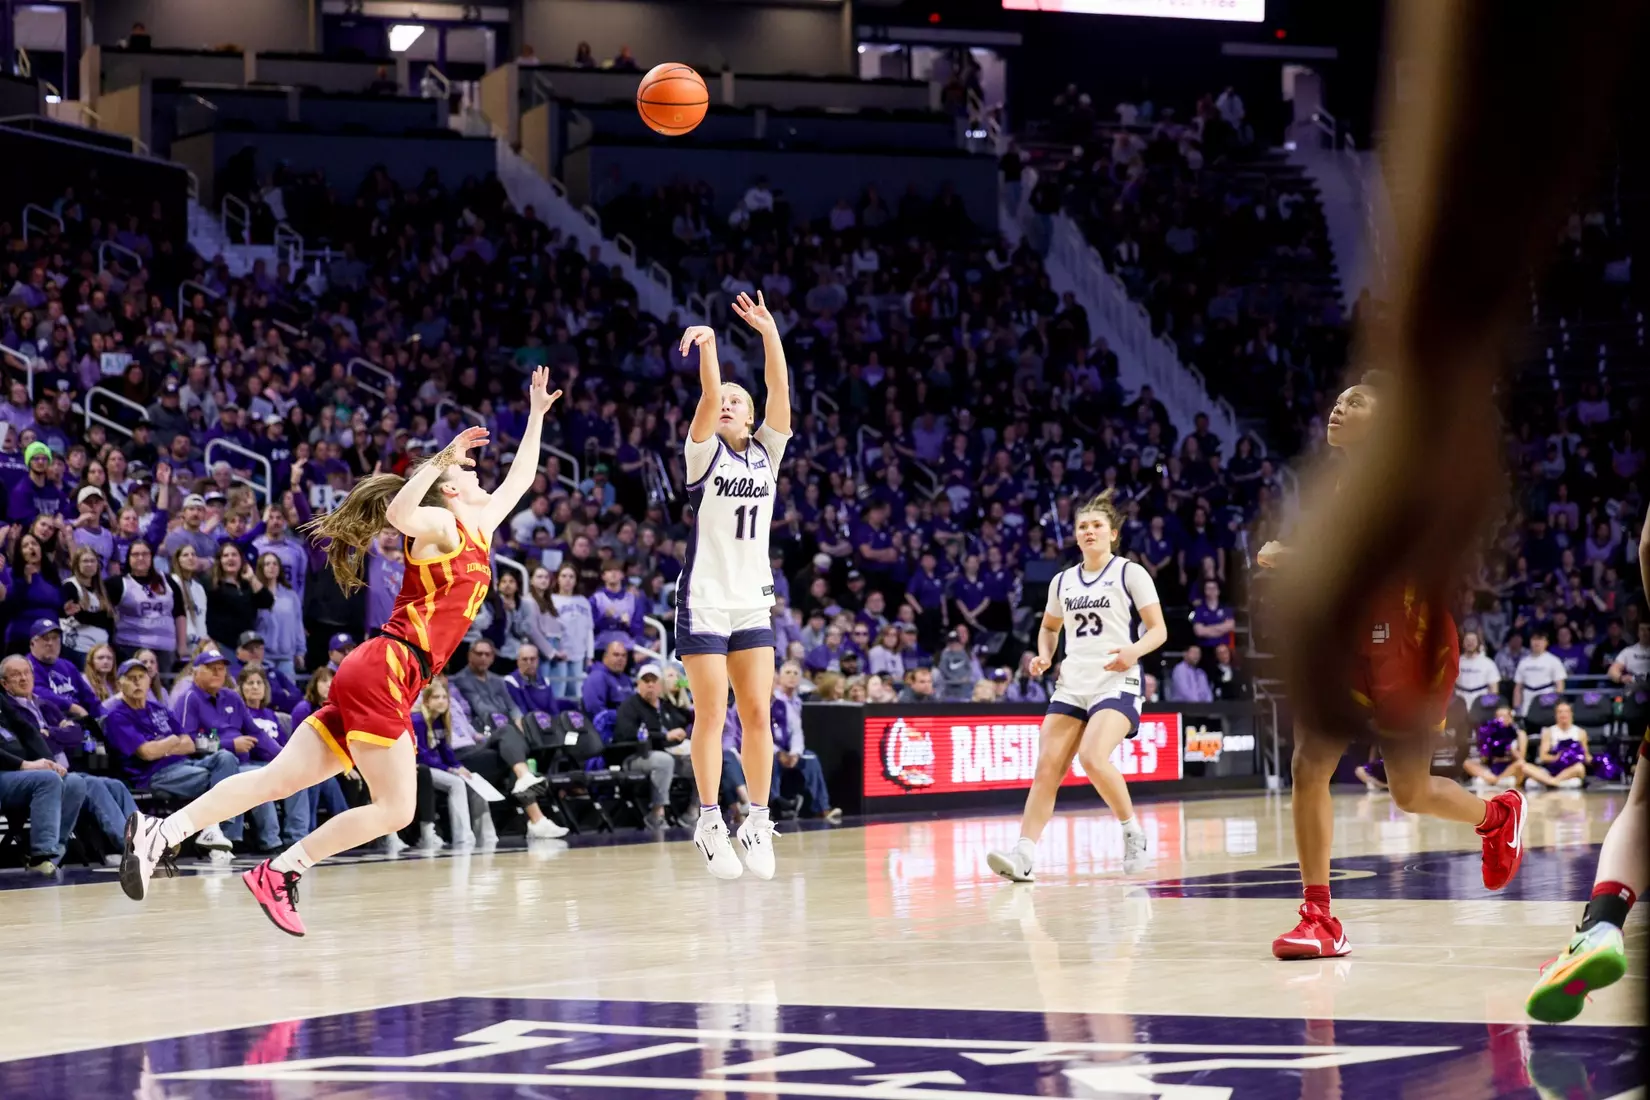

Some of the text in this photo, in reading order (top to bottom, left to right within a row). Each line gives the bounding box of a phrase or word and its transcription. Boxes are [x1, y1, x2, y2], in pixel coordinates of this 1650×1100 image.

[734, 505, 759, 540] 11
[463, 581, 488, 621] 12
[1064, 595, 1111, 612] Wildcats
[1074, 612, 1103, 638] 23
[951, 724, 1039, 783] RAISI
